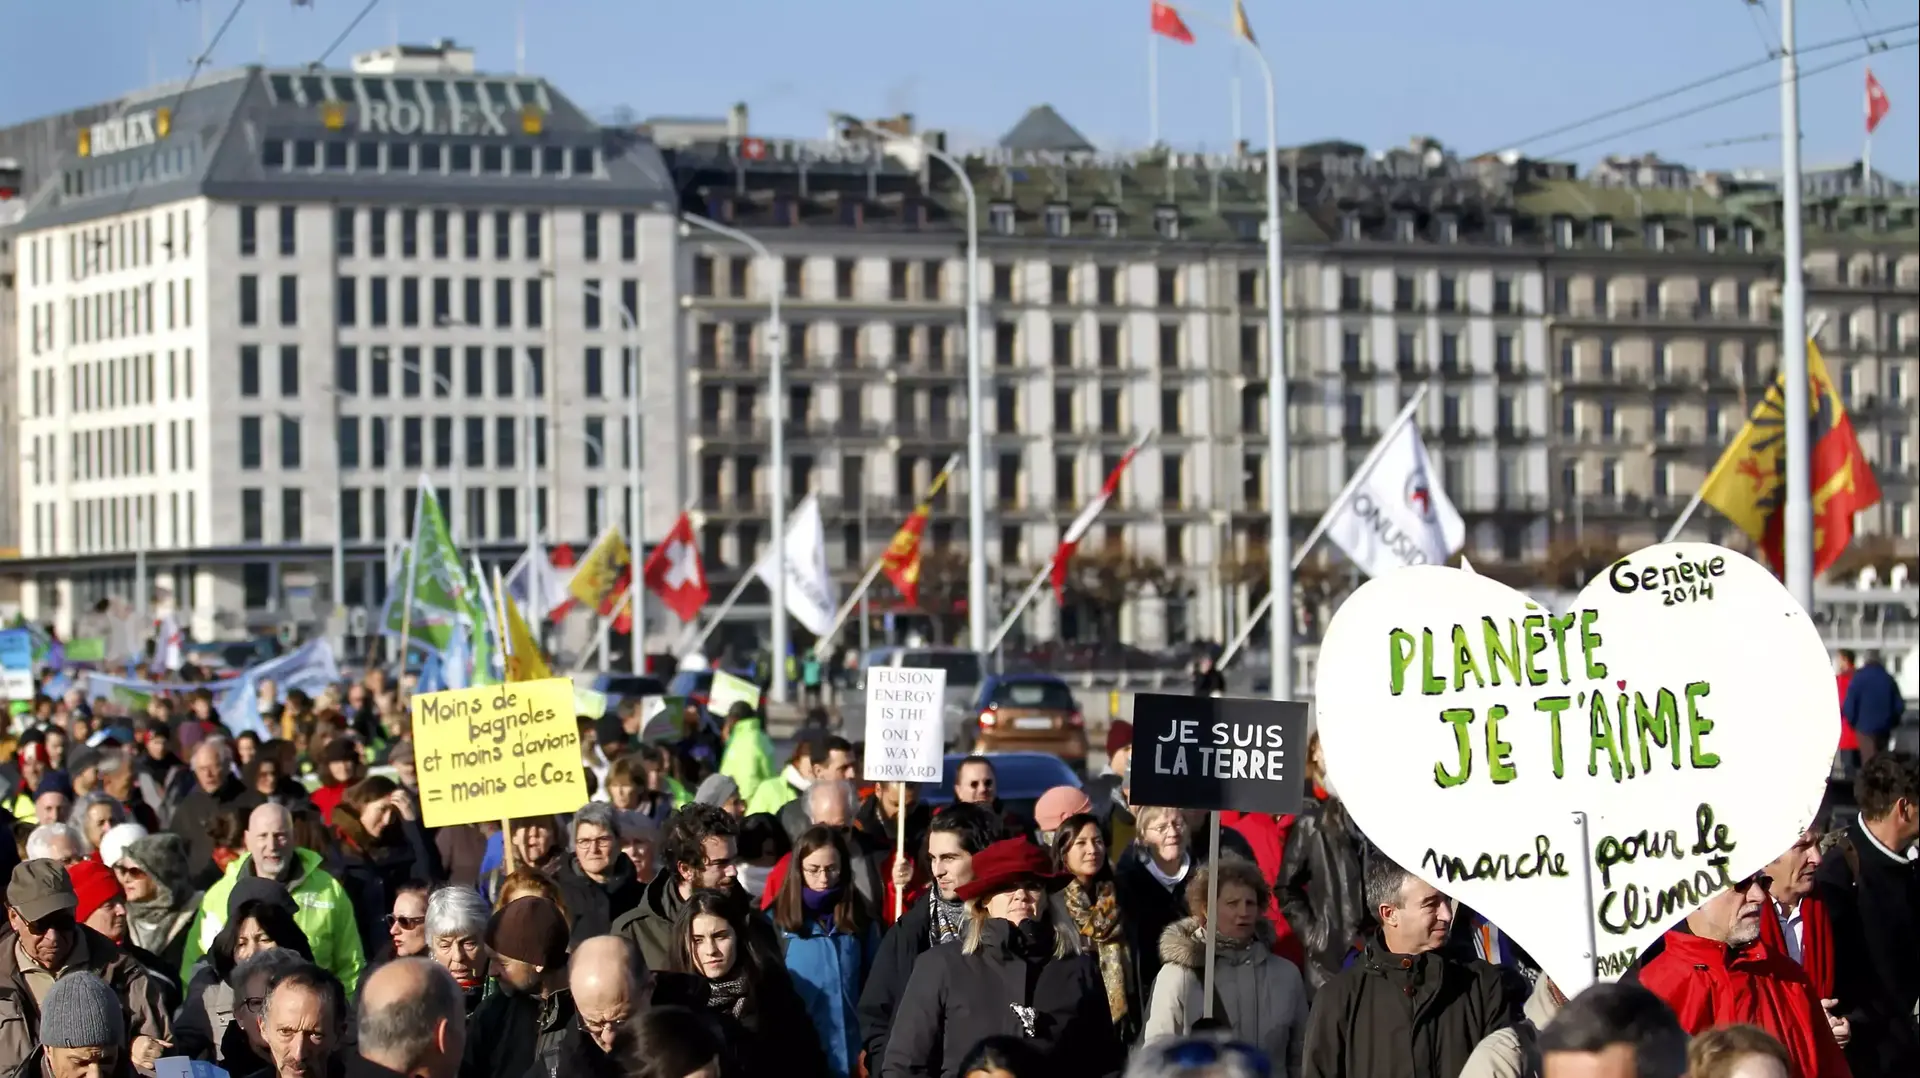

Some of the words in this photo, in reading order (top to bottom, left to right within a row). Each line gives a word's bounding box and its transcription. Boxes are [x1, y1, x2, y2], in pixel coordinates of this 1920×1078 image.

[90, 110, 156, 157] ROLEX
[358, 101, 508, 136] ROLEX
[1609, 552, 1726, 594] Genève
[1660, 581, 1715, 607] 2014
[878, 671, 934, 684] FUSION
[421, 696, 483, 725] Moins
[492, 684, 517, 711] de
[875, 689, 936, 703] ENERGY
[469, 698, 557, 744] bagnoles
[881, 707, 894, 720] IS
[900, 708, 926, 721] THE
[423, 749, 442, 772] et
[451, 745, 503, 769] moins
[512, 730, 577, 757] d'avions
[882, 728, 924, 742] ONLY
[1158, 720, 1199, 743] JE
[1212, 723, 1283, 748] SUIS
[1434, 704, 1518, 789] JE
[885, 747, 920, 760] WAY
[1154, 743, 1189, 775] LA
[1199, 747, 1284, 781] TERRE
[451, 777, 507, 803] moins
[1422, 834, 1569, 883] marche
[1595, 829, 1685, 889] pour
[1691, 802, 1737, 855] le
